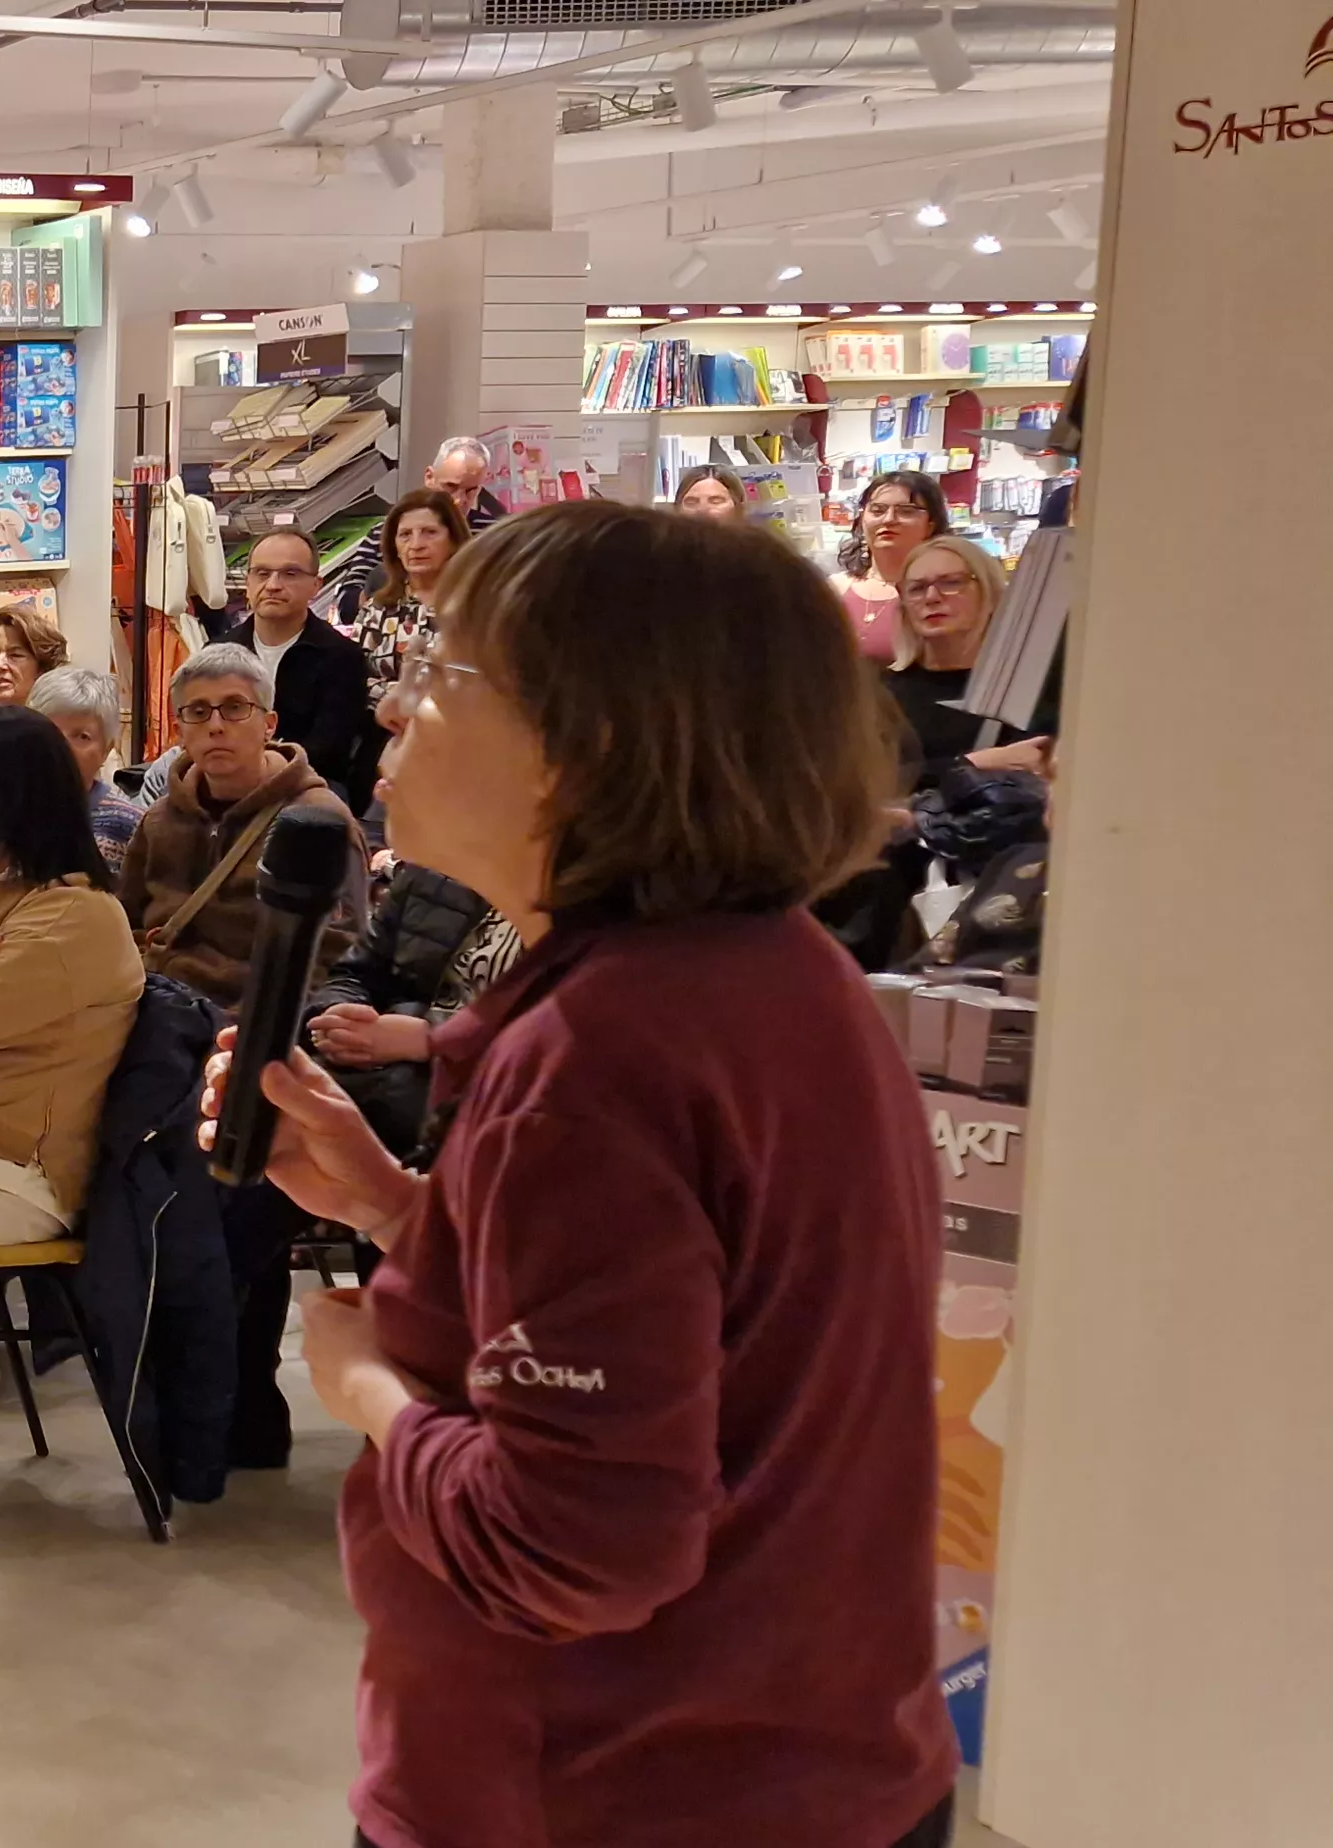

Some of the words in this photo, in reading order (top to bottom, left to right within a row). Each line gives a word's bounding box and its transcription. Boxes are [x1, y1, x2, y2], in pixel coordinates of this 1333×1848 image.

[1172, 97, 1333, 160] SANTOS
[278, 315, 323, 331] CANSON
[291, 339, 311, 366] XL
[933, 1110, 1022, 1178] ART
